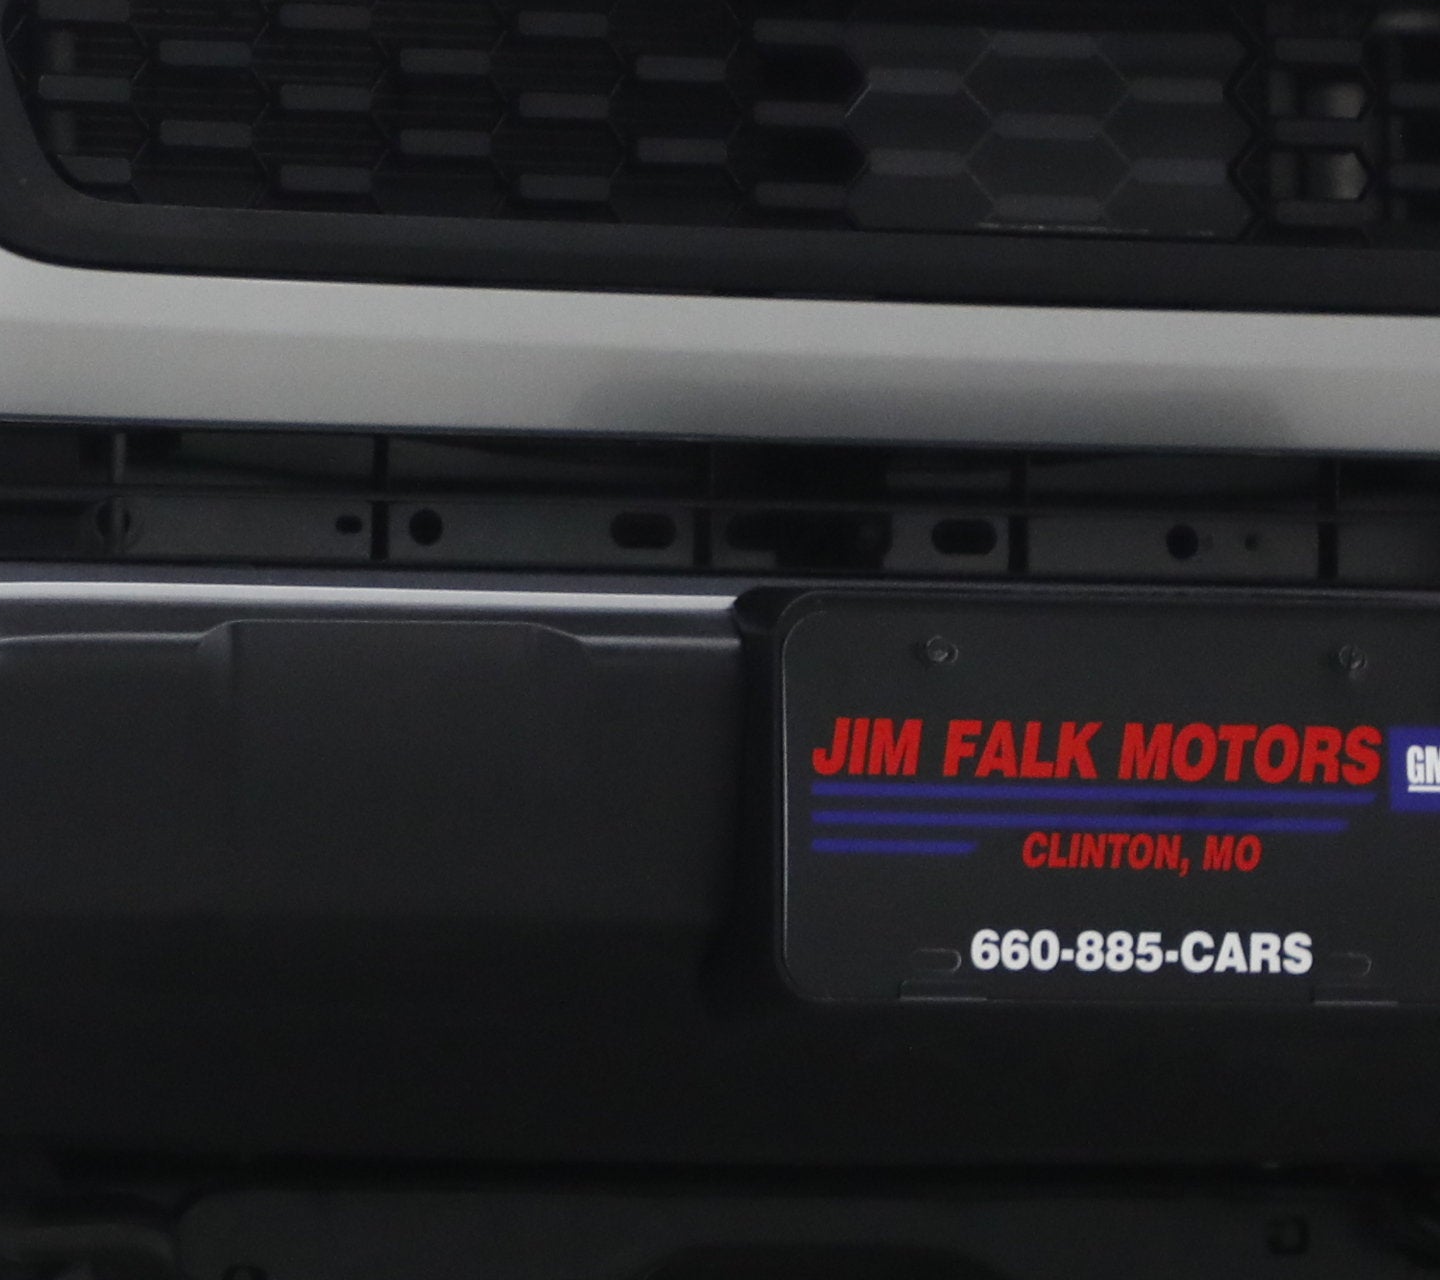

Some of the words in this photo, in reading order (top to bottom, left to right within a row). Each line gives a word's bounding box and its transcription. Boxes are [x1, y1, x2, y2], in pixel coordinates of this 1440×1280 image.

[812, 717, 923, 776] JIM
[942, 719, 1103, 780] FALK
[1118, 722, 1382, 785] MOTORS
[1021, 831, 1190, 877] CLINTON,
[1202, 834, 1263, 872] MO
[970, 928, 1314, 975] 660-885-CARS
